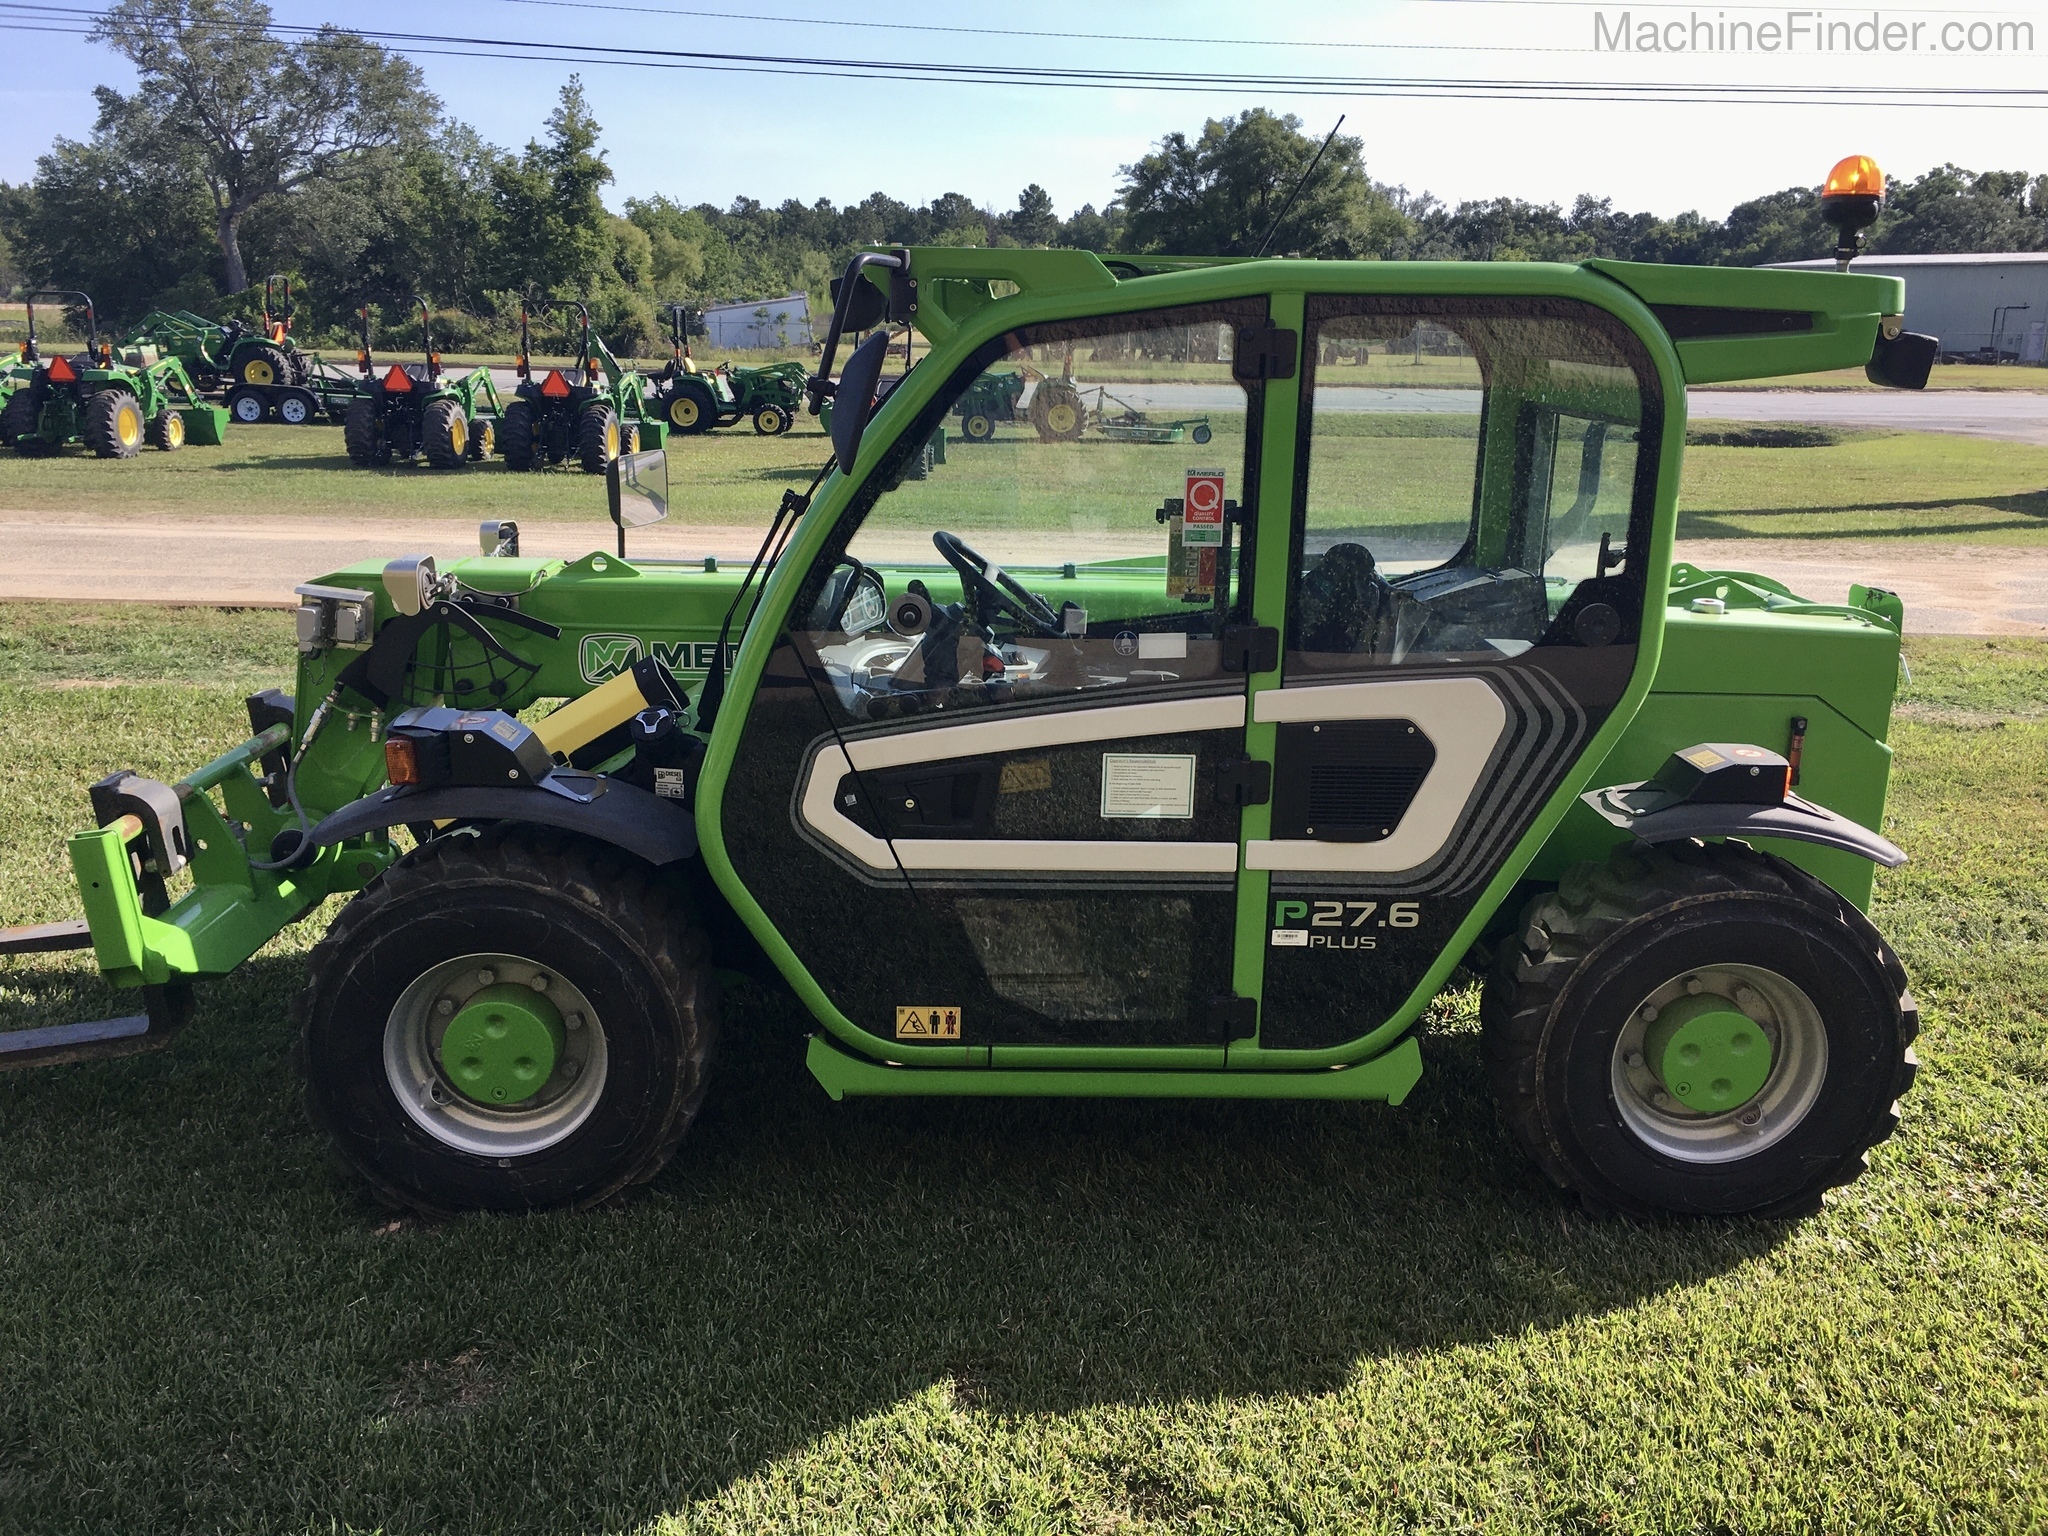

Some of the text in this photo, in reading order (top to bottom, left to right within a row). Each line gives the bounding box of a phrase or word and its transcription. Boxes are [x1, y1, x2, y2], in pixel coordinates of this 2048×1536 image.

[1189, 480, 1220, 511] Q
[1275, 901, 1420, 928] P27.6
[1309, 935, 1376, 949] PLUS
